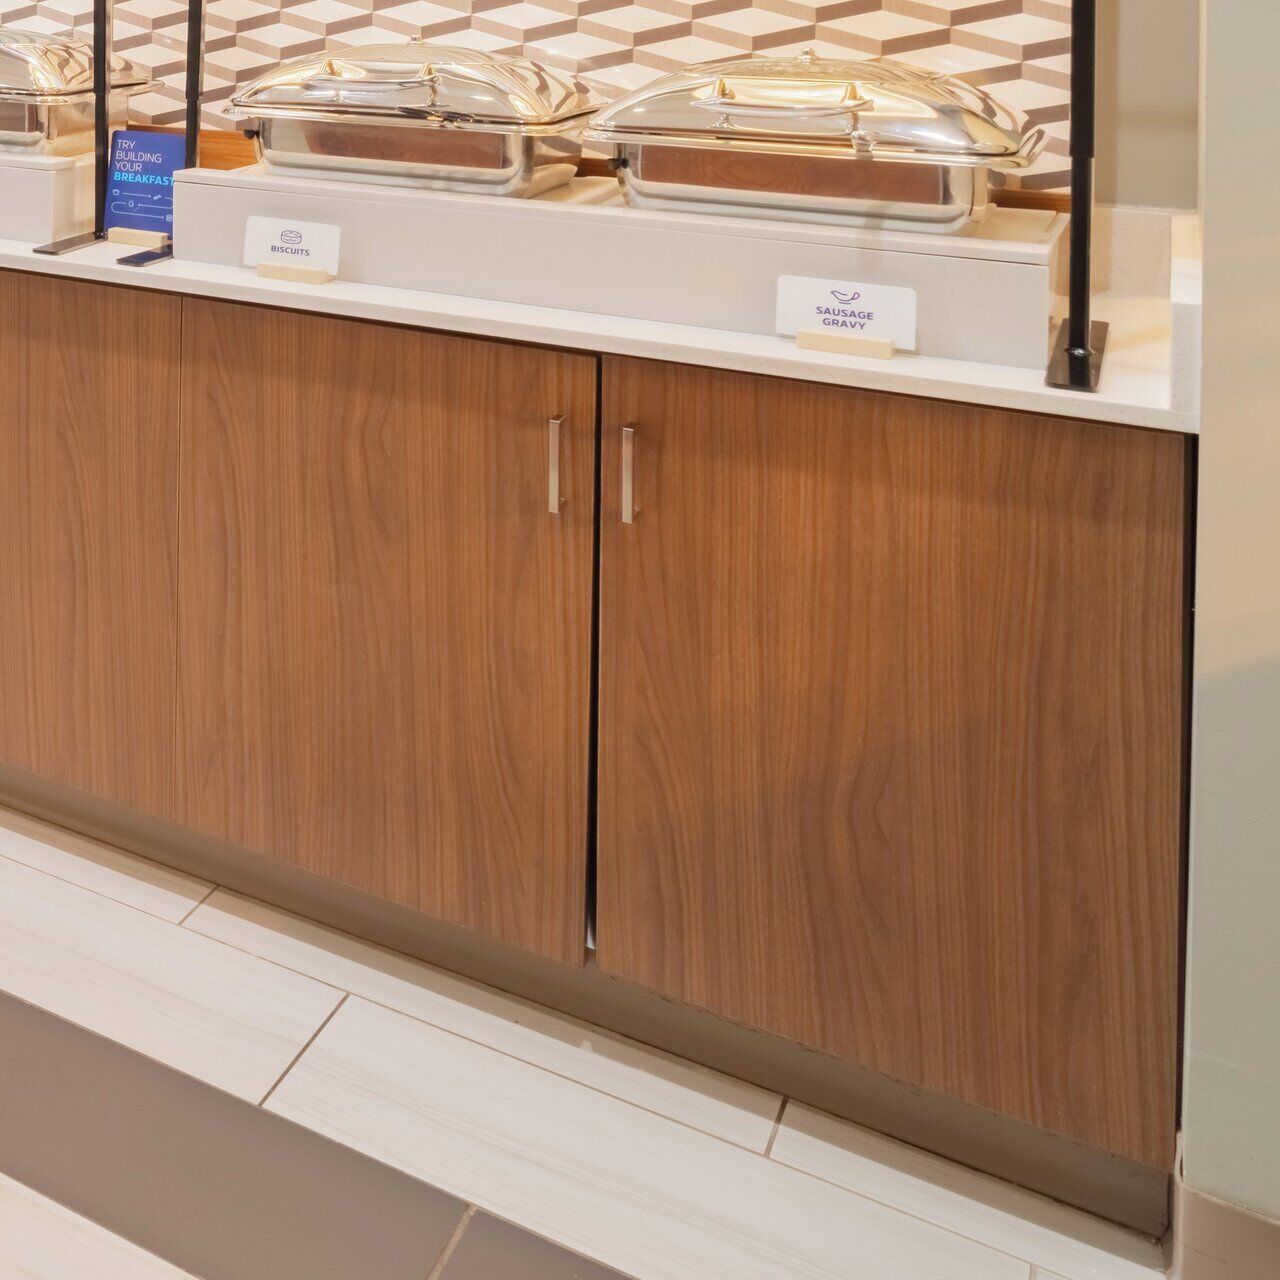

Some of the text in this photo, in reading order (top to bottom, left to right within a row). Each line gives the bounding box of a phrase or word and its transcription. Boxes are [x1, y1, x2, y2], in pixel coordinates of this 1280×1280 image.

[117, 139, 136, 150] TRY
[116, 150, 162, 164] BUILDING
[115, 161, 143, 172] YOUR
[271, 245, 310, 257] BISCUITS
[816, 306, 874, 320] SAUSAGE
[822, 317, 866, 330] GRAVY
